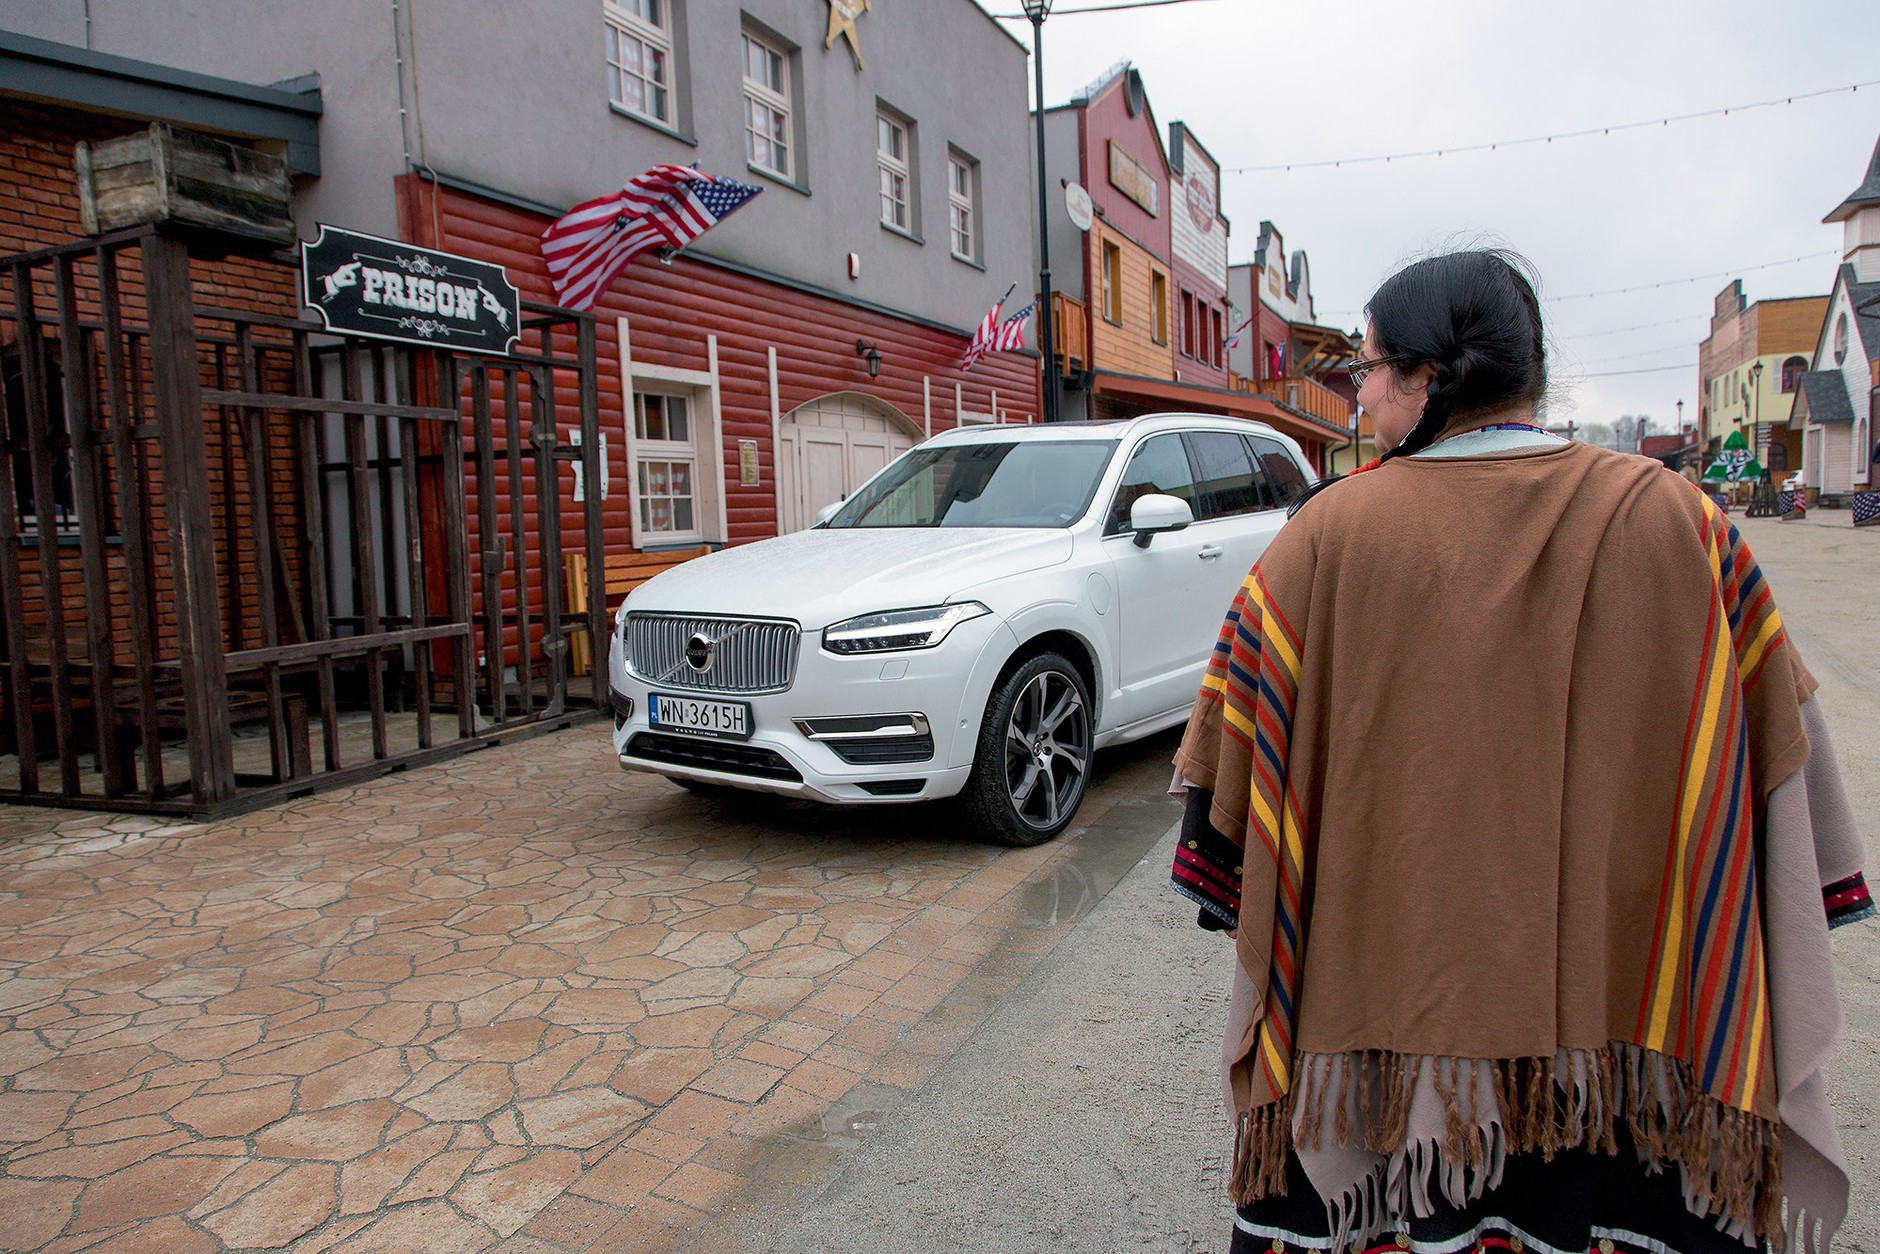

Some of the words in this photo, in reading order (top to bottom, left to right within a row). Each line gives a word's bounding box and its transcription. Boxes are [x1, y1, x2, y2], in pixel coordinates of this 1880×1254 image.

[361, 266, 478, 321] PRISON
[660, 699, 684, 724] WN
[690, 703, 744, 731] 3615H
